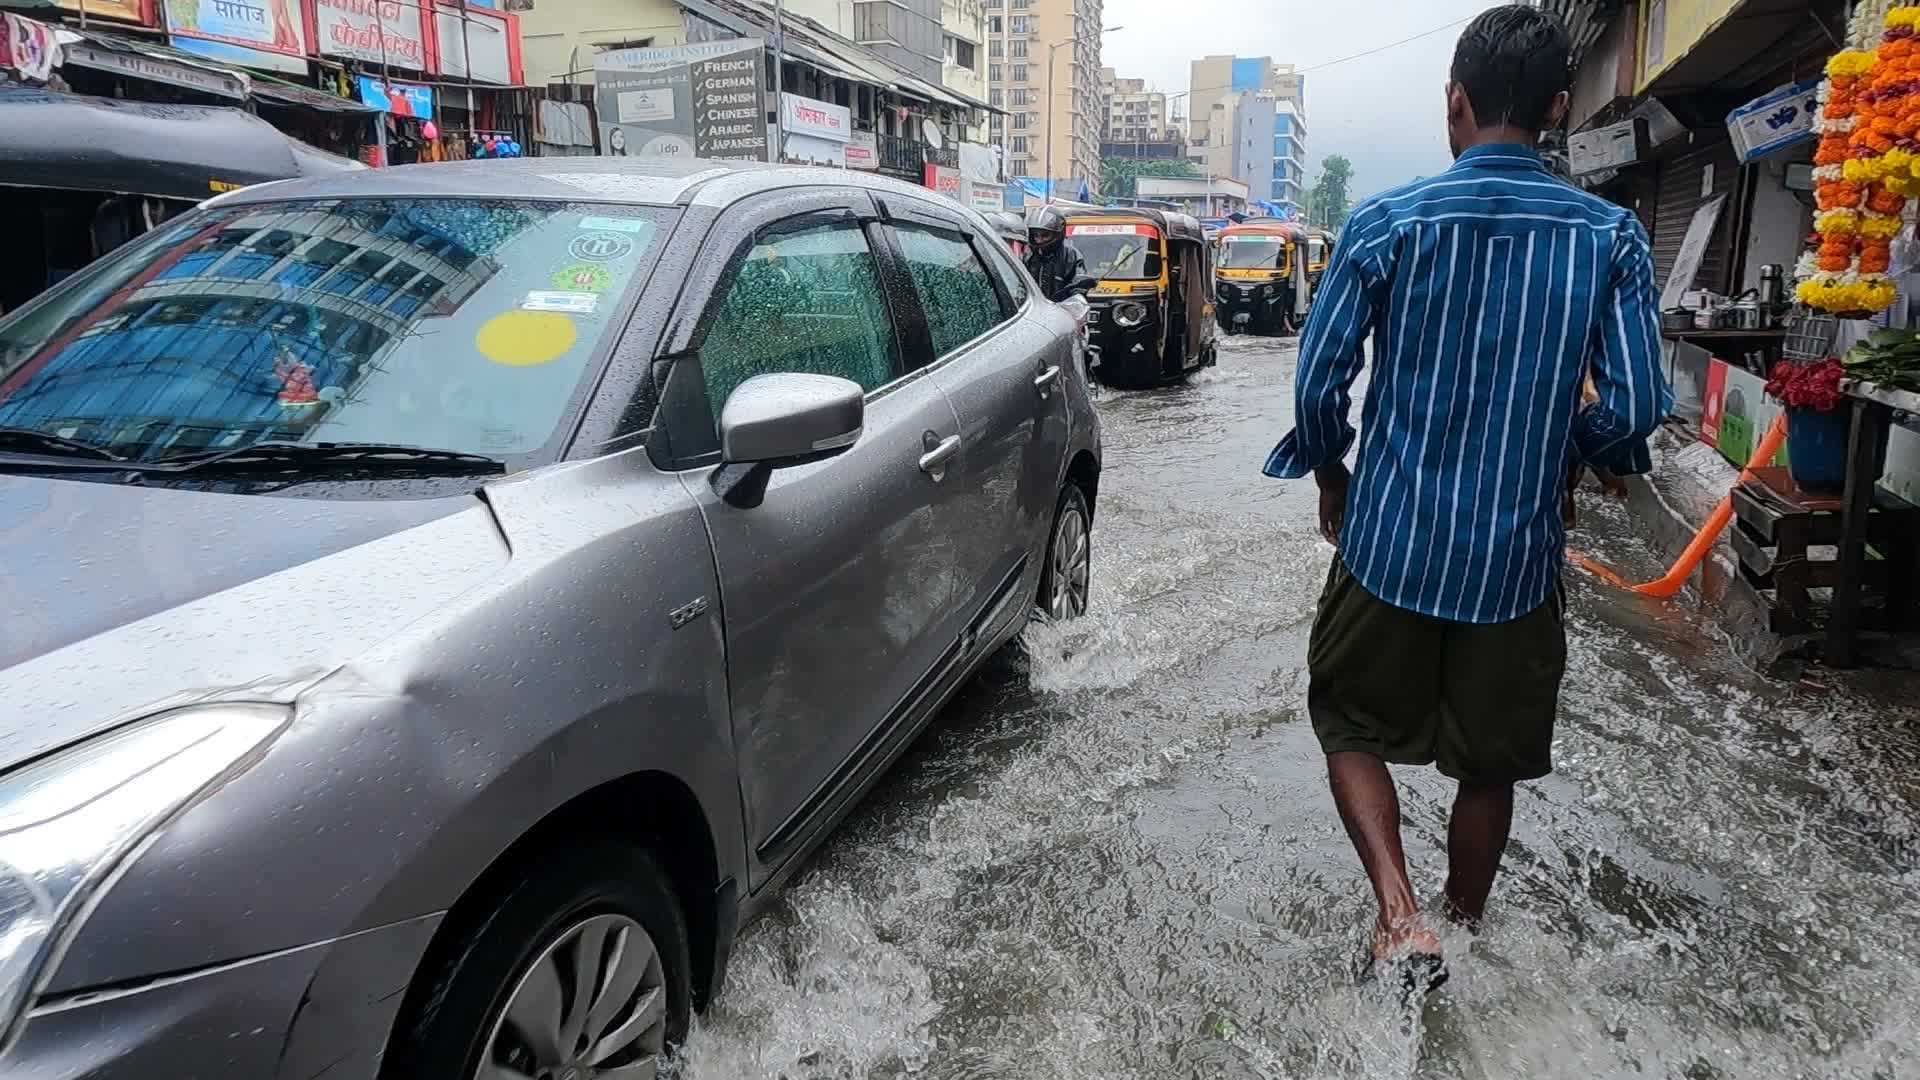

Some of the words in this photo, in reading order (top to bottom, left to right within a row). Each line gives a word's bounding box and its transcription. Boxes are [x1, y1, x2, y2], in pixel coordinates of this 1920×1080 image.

[703, 60, 755, 73] FRENCH
[705, 76, 755, 89] GERMAN
[706, 92, 757, 105] SPANISH
[707, 107, 759, 121] CHINESE
[709, 124, 753, 136] ARABIC
[710, 137, 765, 150] JAPANESE
